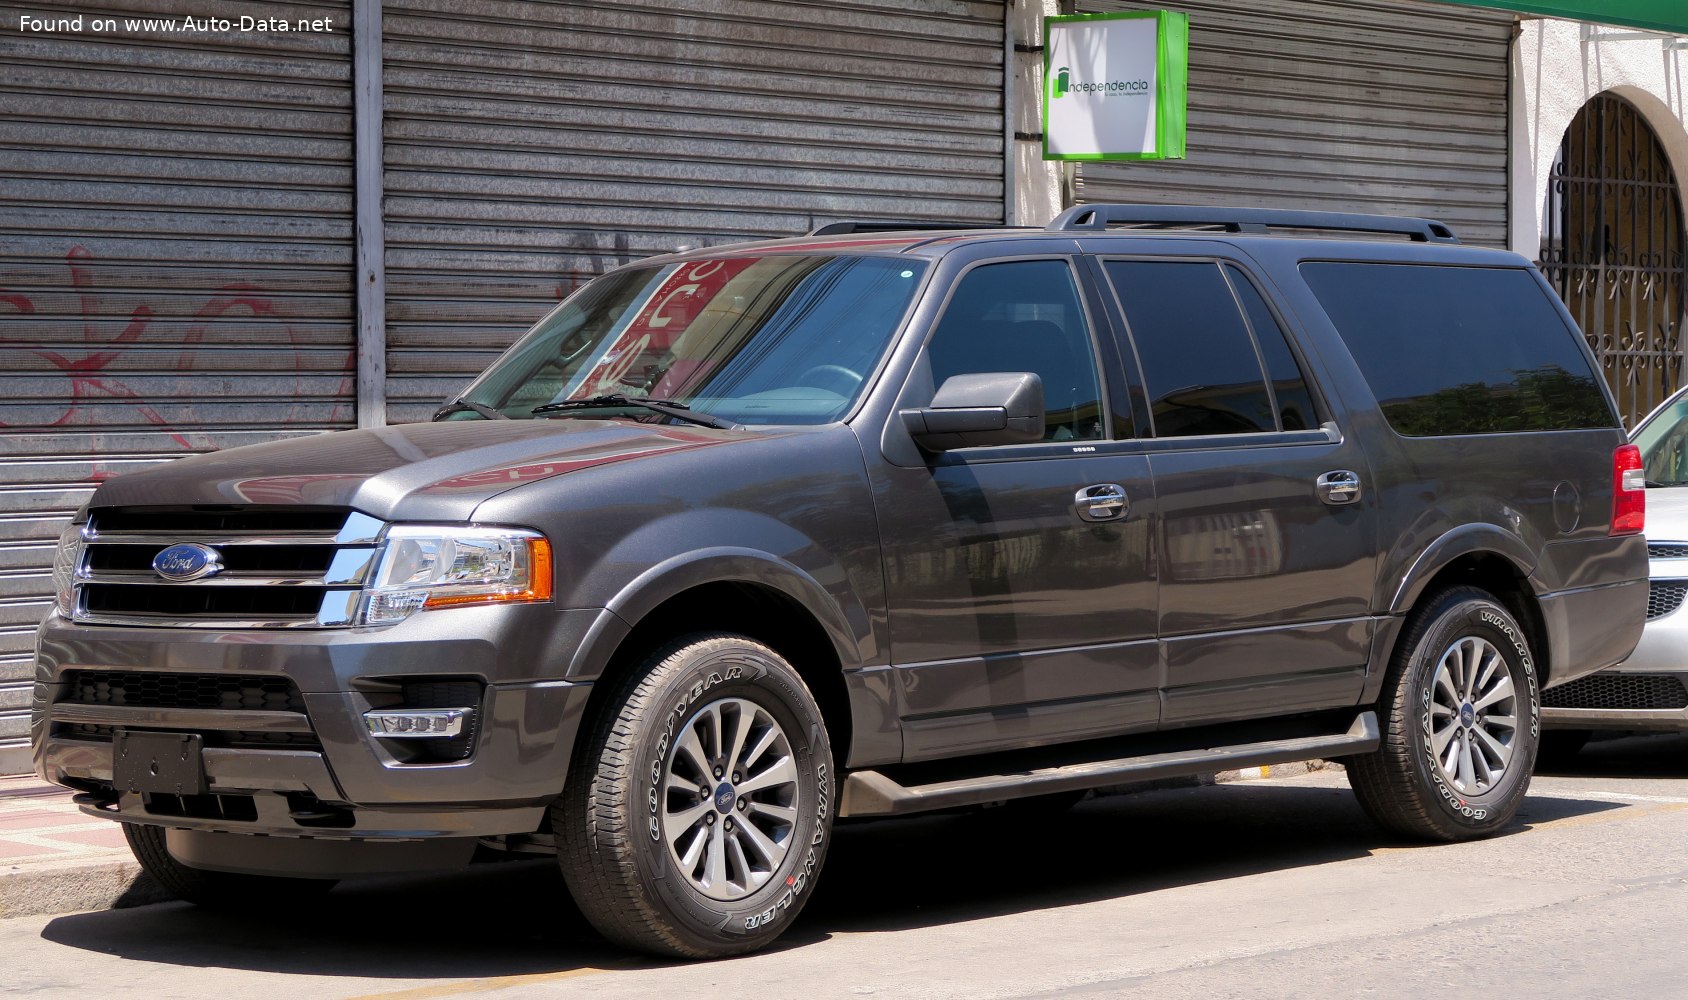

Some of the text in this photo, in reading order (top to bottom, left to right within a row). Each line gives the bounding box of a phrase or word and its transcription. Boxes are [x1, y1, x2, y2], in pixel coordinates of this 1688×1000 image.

[162, 549, 196, 570] Ford
[1480, 610, 1538, 738] WRANGLER
[648, 666, 744, 841] GOODYEAR
[1421, 687, 1487, 820] GOODYEAR
[744, 763, 828, 930] WRANGLER
